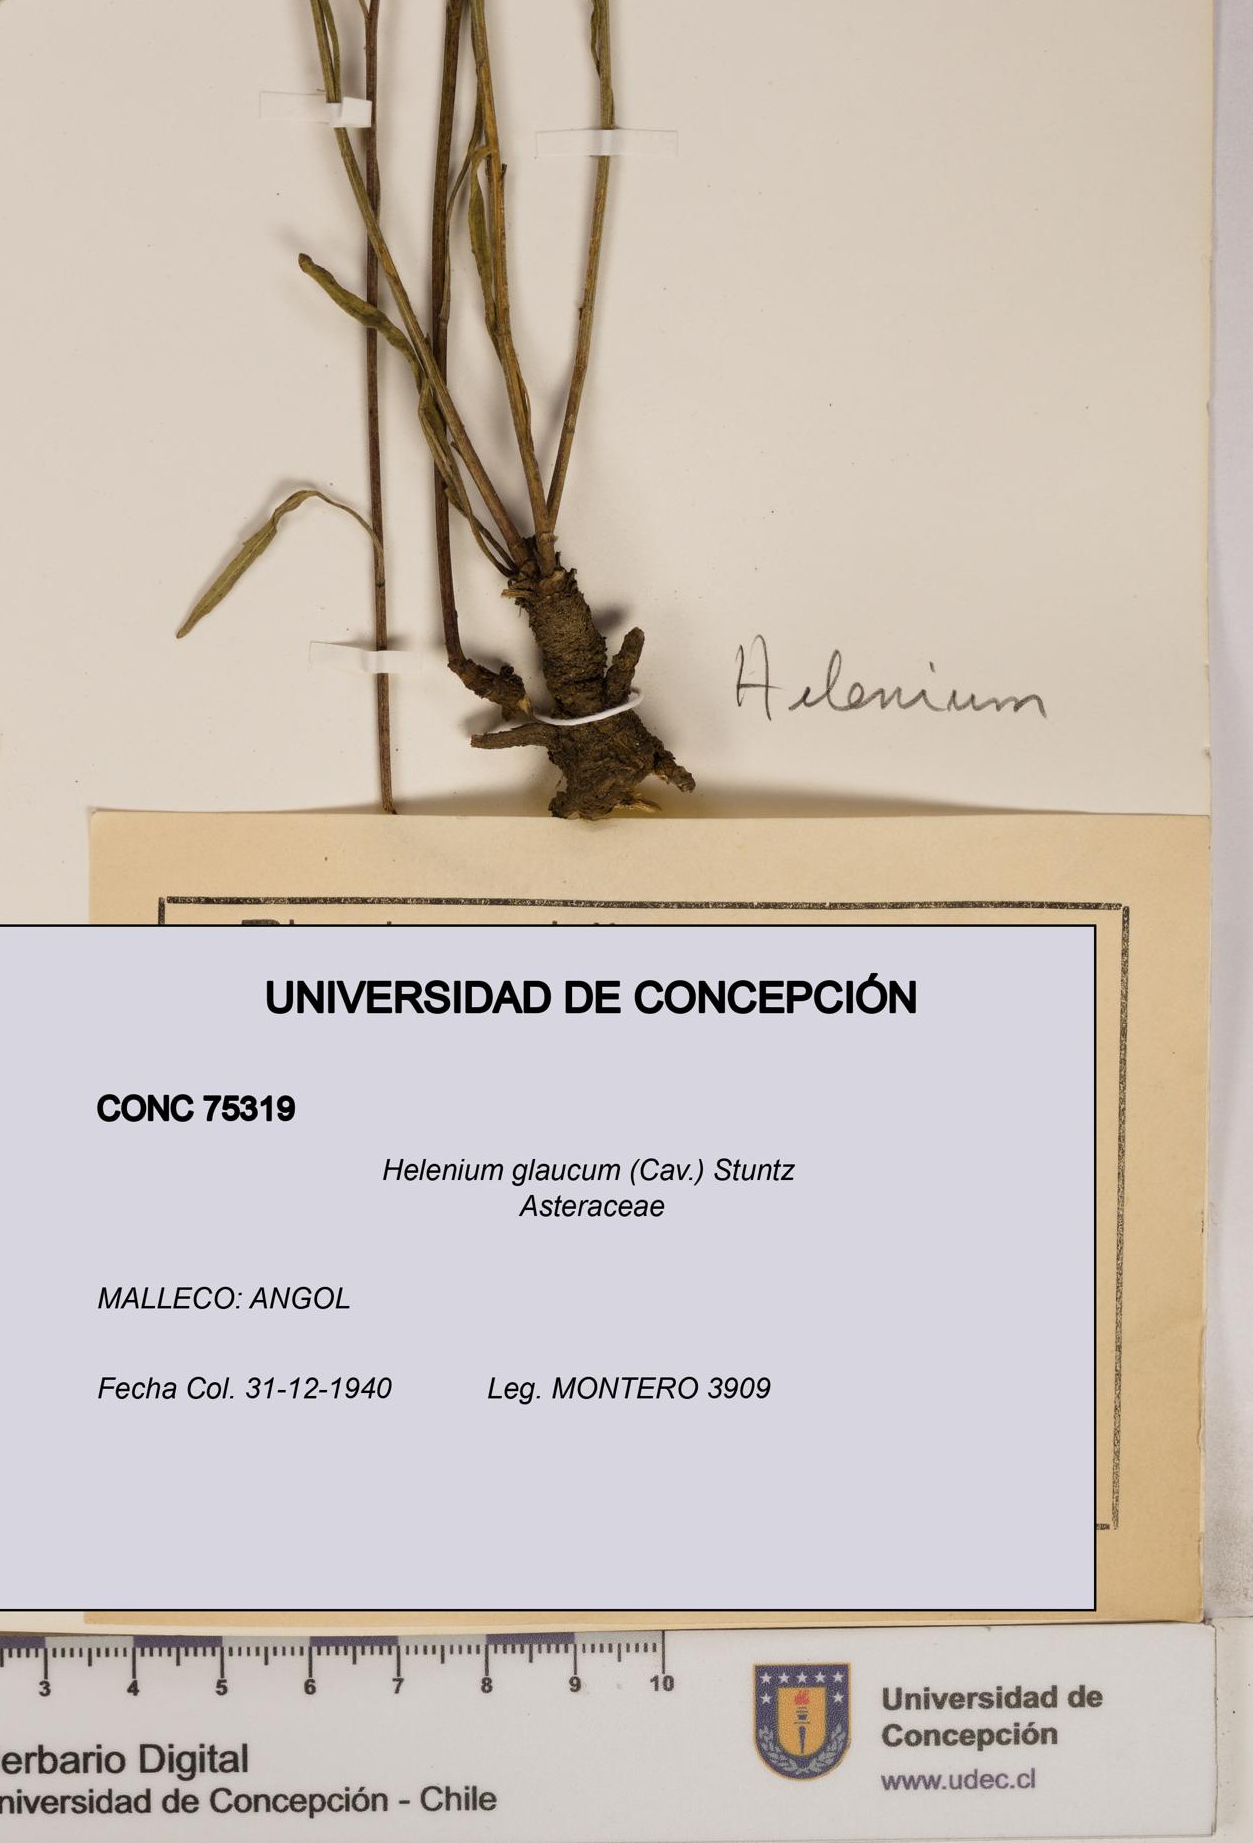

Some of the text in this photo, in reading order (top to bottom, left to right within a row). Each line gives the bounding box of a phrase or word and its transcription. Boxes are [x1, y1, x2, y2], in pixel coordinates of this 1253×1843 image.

[38, 1680, 52, 1698] 3
[126, 1680, 141, 1697] 4
[214, 1679, 229, 1697] 5
[303, 1678, 317, 1696] 6
[391, 1678, 405, 1695] 7
[480, 1677, 494, 1694] 8
[568, 1676, 582, 1693] 9
[649, 1675, 675, 1692] 10
[882, 1684, 1104, 1711] Universidad de
[881, 1721, 1058, 1752] Concepción
[139, 1742, 249, 1779] Digital
[880, 1767, 1036, 1791] www.udec.cl
[161, 1787, 200, 1814] de
[209, 1786, 389, 1819] Concepción
[419, 1785, 498, 1812] Chile
